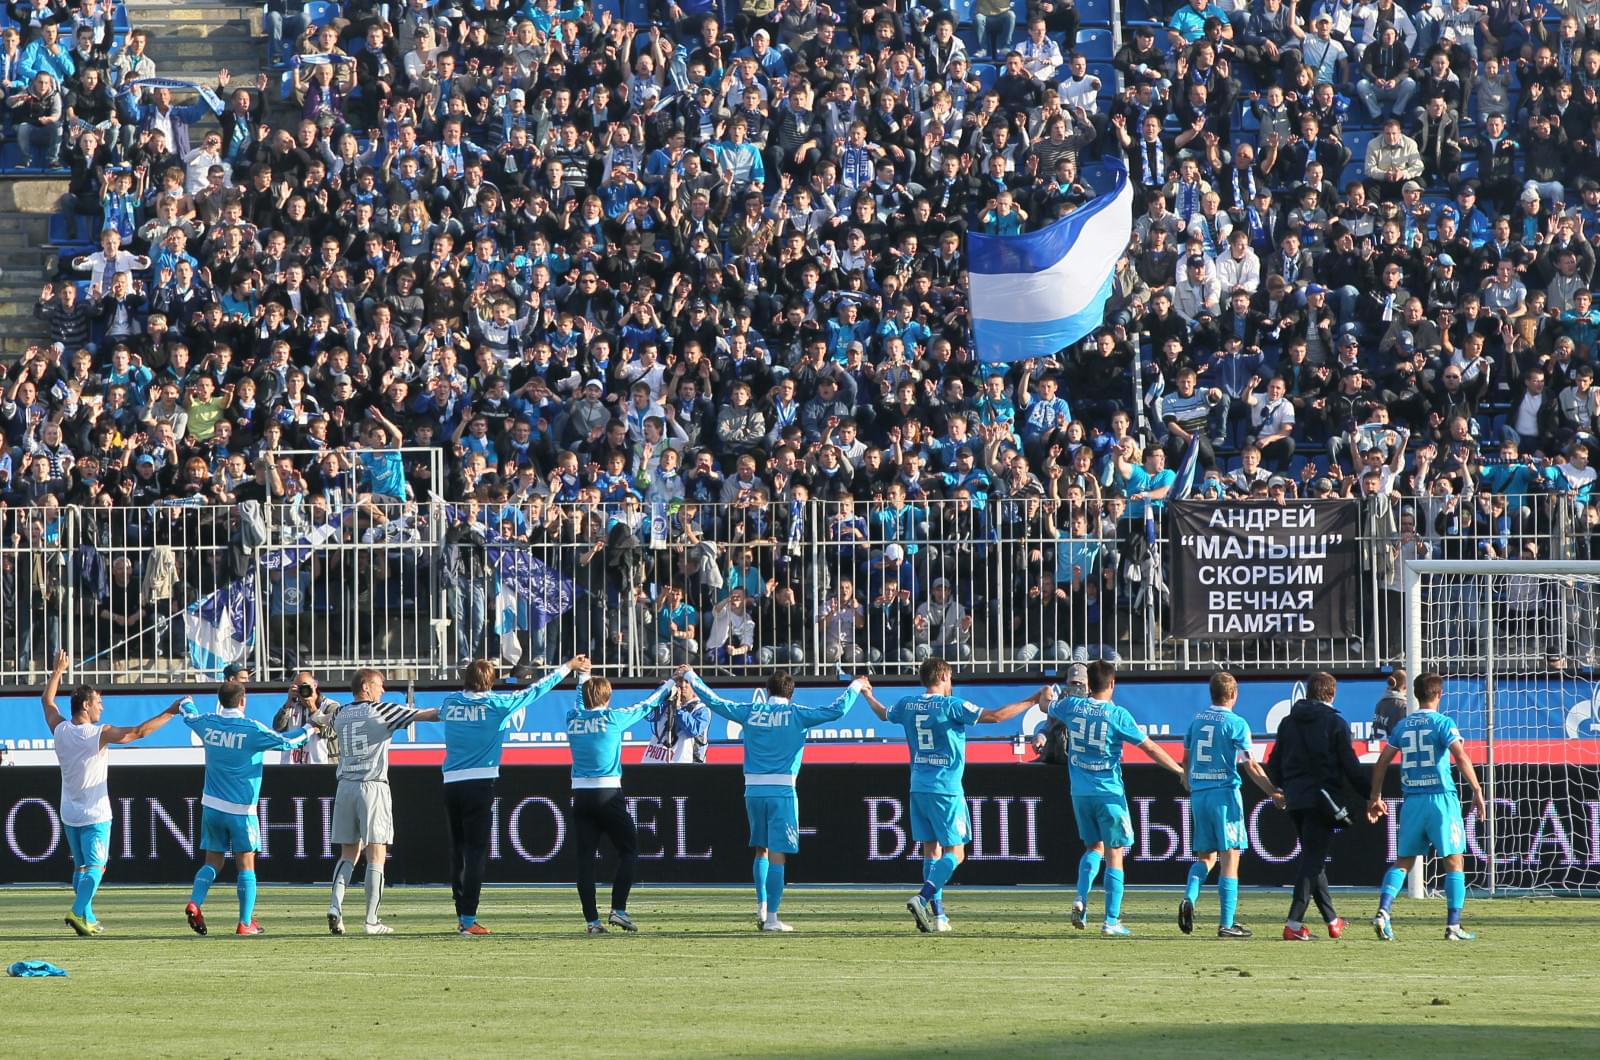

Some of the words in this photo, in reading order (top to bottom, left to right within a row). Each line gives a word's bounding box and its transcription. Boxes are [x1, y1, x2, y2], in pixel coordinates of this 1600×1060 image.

[1209, 504, 1316, 532] АНДРЕЙ
[1199, 565, 1323, 585] СКОРБИМ
[1209, 590, 1314, 610] ВЕЧНАЯ
[1207, 613, 1315, 633] ПАМЯТЬ
[446, 704, 487, 721] ZENIT
[748, 710, 792, 727] ZENIT
[567, 716, 608, 735] ZENIT
[915, 714, 935, 750] 6
[1070, 716, 1109, 756] 24
[204, 727, 248, 749] ZENIT
[342, 720, 370, 757] 16
[1196, 724, 1216, 763] 2
[1401, 729, 1436, 769] 25
